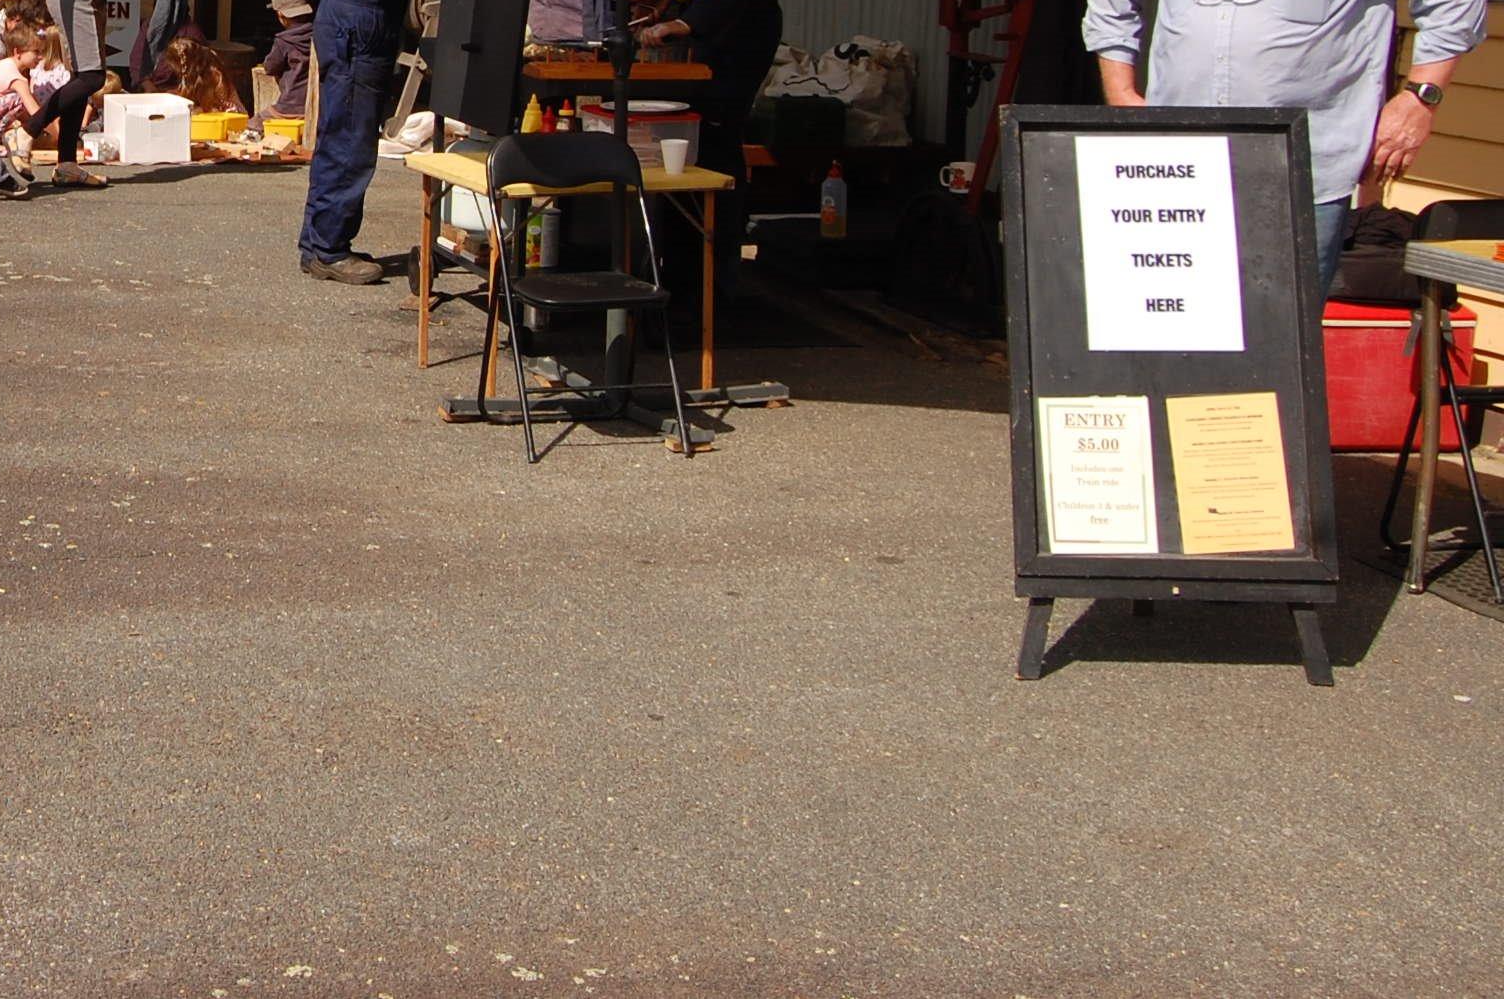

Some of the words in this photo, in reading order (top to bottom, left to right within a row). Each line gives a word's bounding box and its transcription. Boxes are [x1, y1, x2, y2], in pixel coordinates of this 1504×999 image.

[1115, 164, 1196, 179] PURCHASE
[1111, 209, 1152, 223] YOUR
[1158, 209, 1206, 223] ENTRY
[1131, 253, 1193, 267] TICKETS
[1145, 298, 1185, 312] HERE
[1064, 413, 1127, 427] ENTRY
[1077, 437, 1120, 451] $5.00
